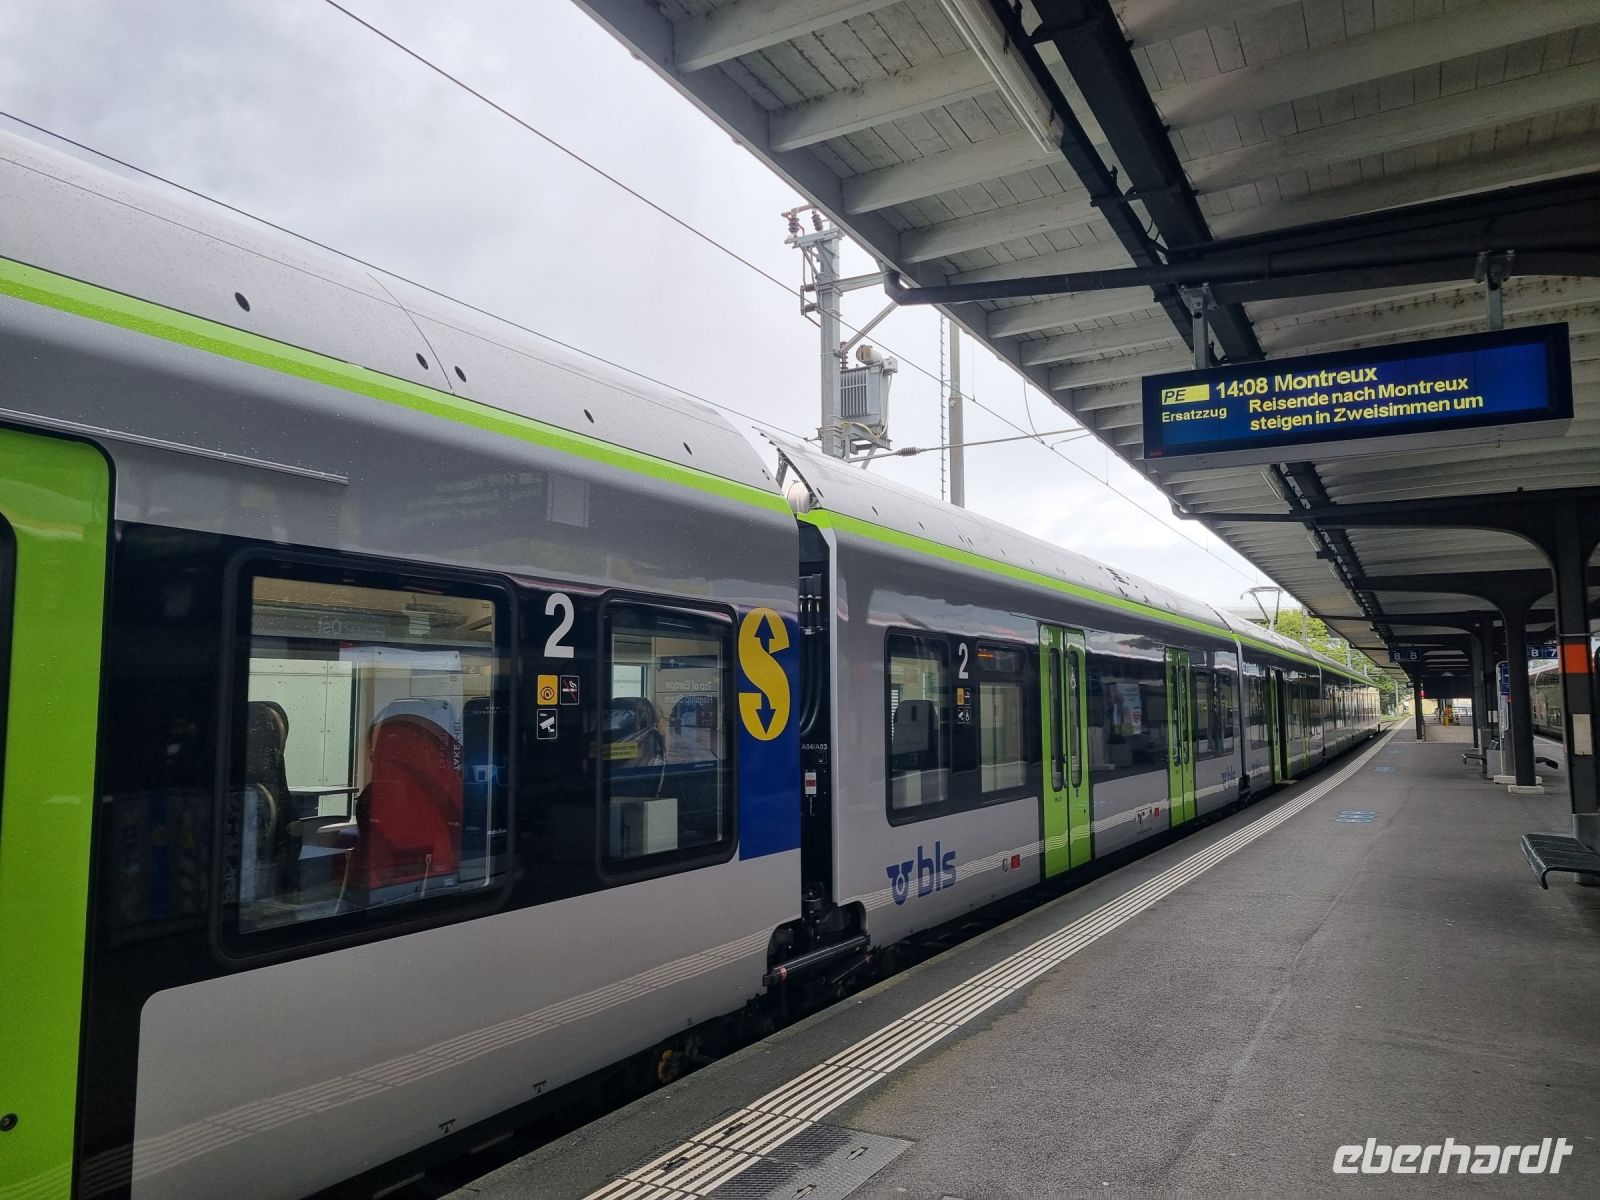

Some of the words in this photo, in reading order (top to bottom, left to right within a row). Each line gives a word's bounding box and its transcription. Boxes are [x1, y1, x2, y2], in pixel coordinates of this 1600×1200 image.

[1163, 388, 1186, 403] PE
[1216, 377, 1269, 399] 14:08
[1274, 367, 1378, 392] Montreux
[1249, 393, 1329, 413] Reisende
[1332, 387, 1376, 404] nach
[1378, 377, 1470, 399] Montreux
[1161, 407, 1228, 423] Ersatzzug
[1250, 412, 1313, 431] steigen
[1315, 409, 1331, 425] in
[1333, 398, 1450, 423] Zweisimmen
[1453, 395, 1484, 410] um
[543, 592, 576, 659] 2
[958, 642, 969, 680] 2
[1530, 648, 1539, 658] B
[917, 840, 957, 898] bls
